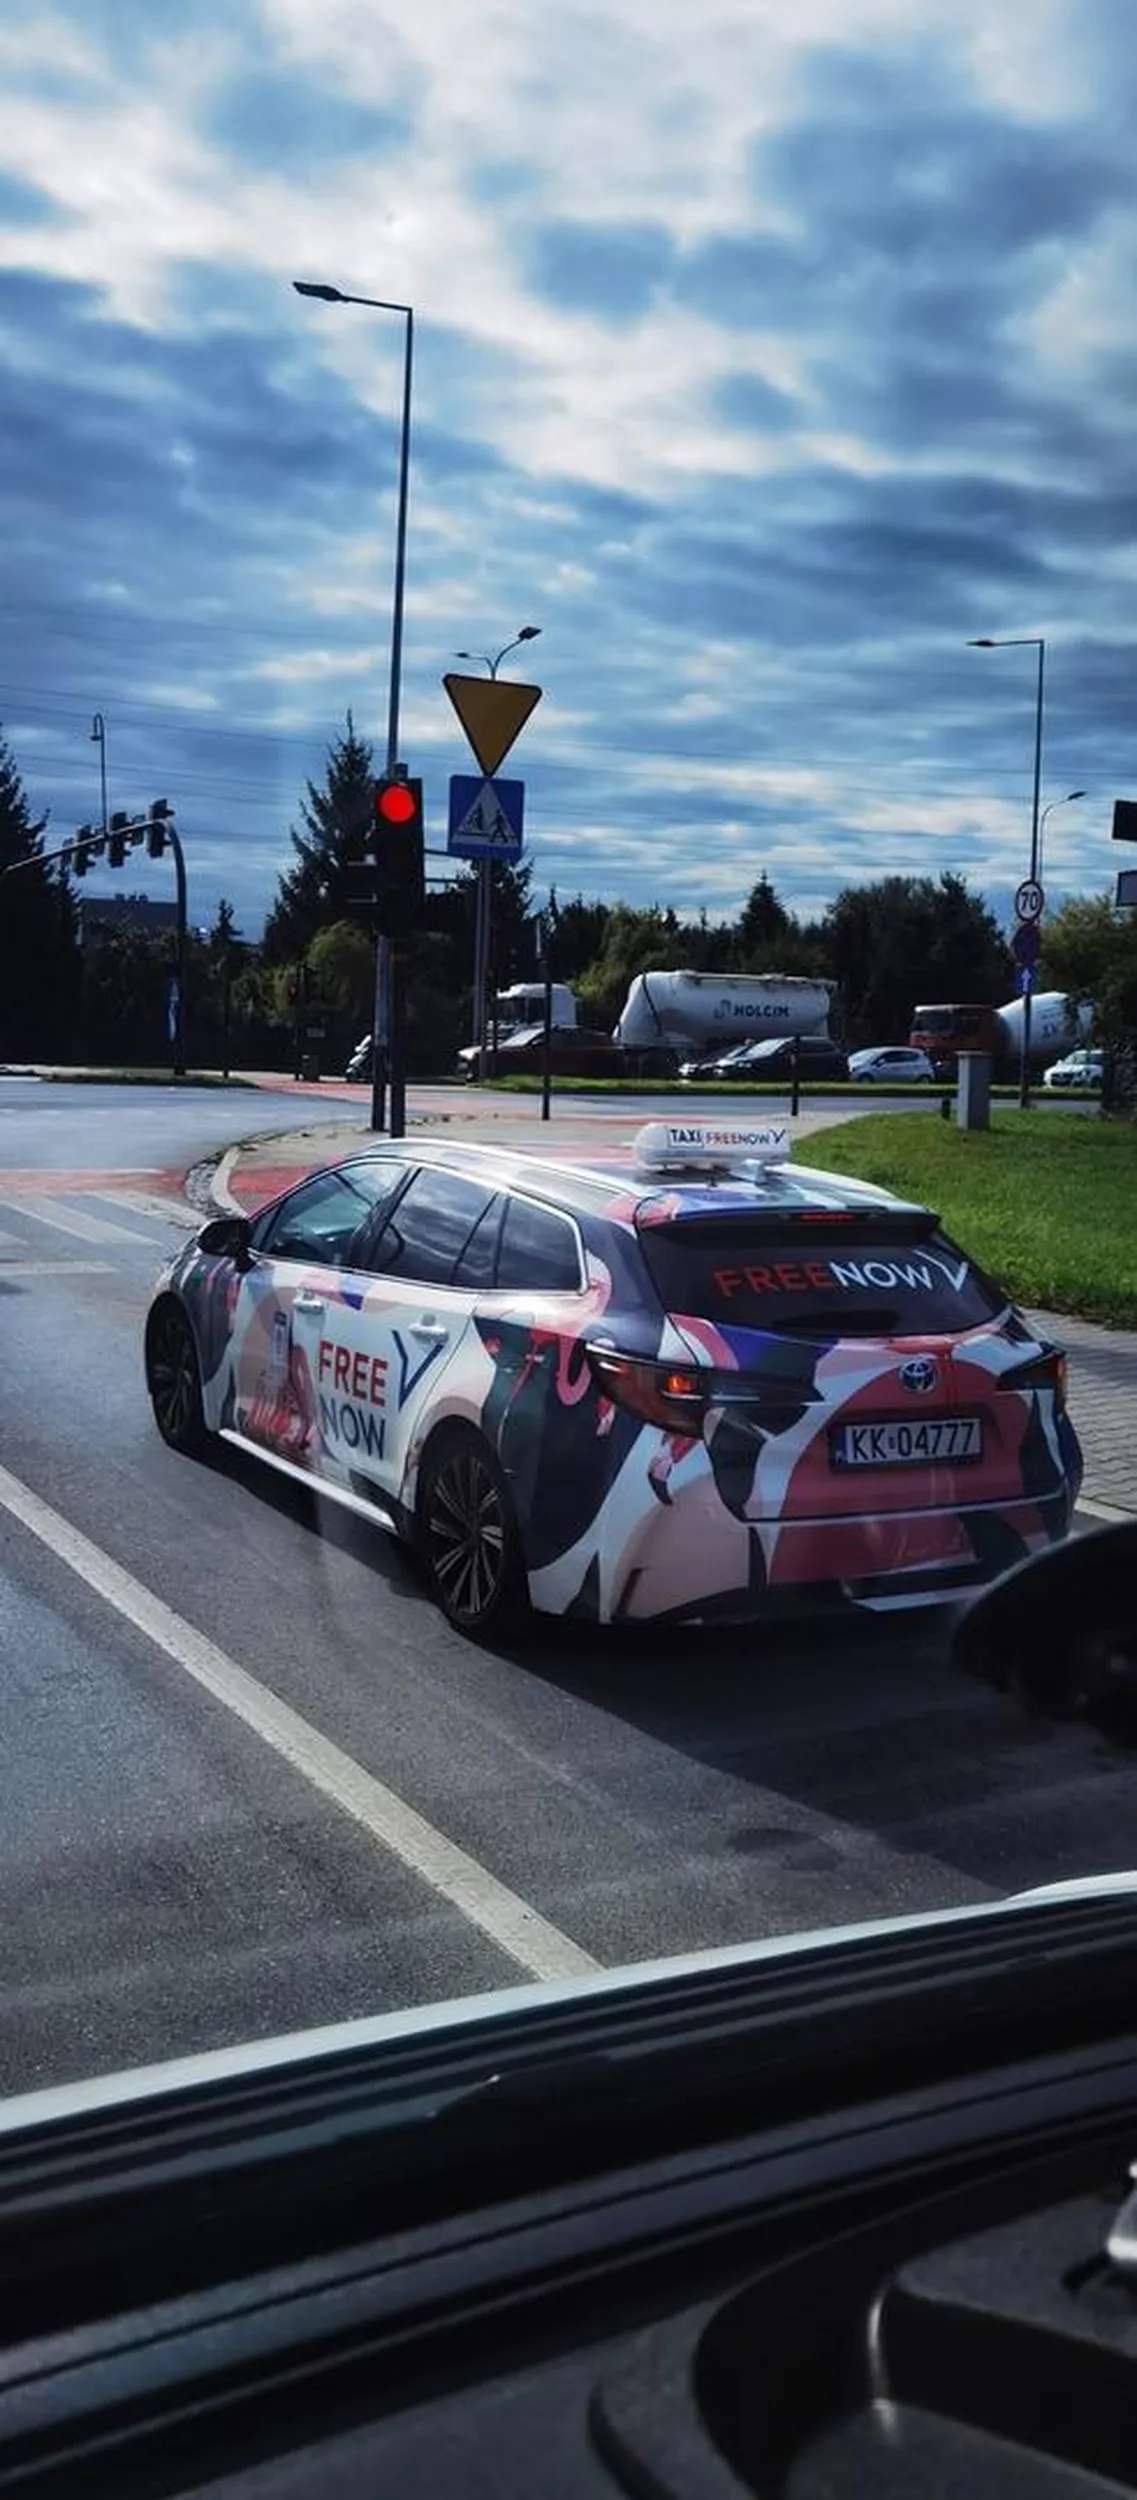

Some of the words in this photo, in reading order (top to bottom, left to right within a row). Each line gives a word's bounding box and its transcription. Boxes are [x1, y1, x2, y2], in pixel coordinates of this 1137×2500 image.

[1020, 891, 1039, 911] 70
[733, 1004, 790, 1018] HOLCIM
[669, 1129, 701, 1143] TAXI
[318, 1339, 388, 1407] FREE
[319, 1393, 386, 1461] NOW
